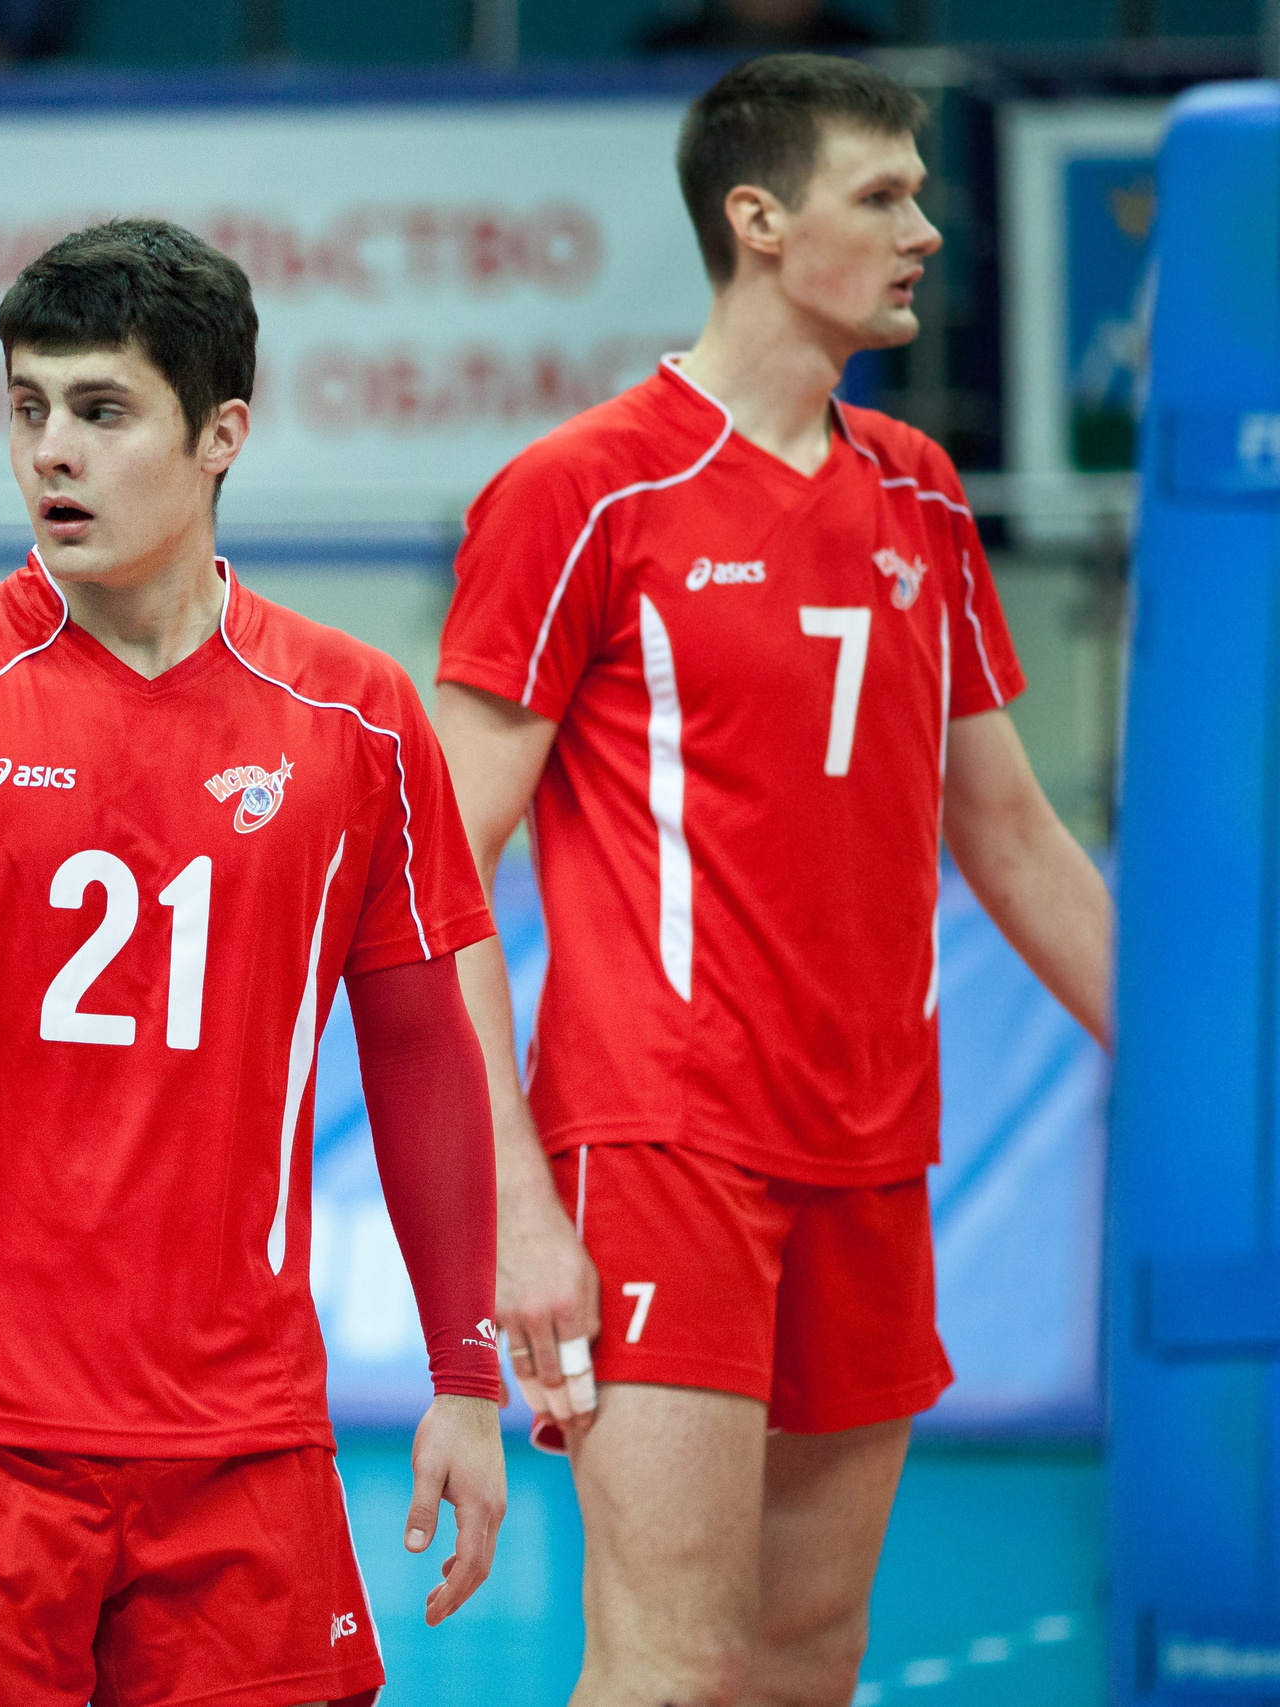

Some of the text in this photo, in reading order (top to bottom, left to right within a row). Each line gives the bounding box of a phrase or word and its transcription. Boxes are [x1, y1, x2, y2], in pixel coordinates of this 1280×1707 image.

[713, 561, 766, 585] asics
[799, 606, 871, 777] 7
[13, 765, 77, 790] asics
[40, 849, 212, 1050] 21
[622, 1282, 656, 1344] 7
